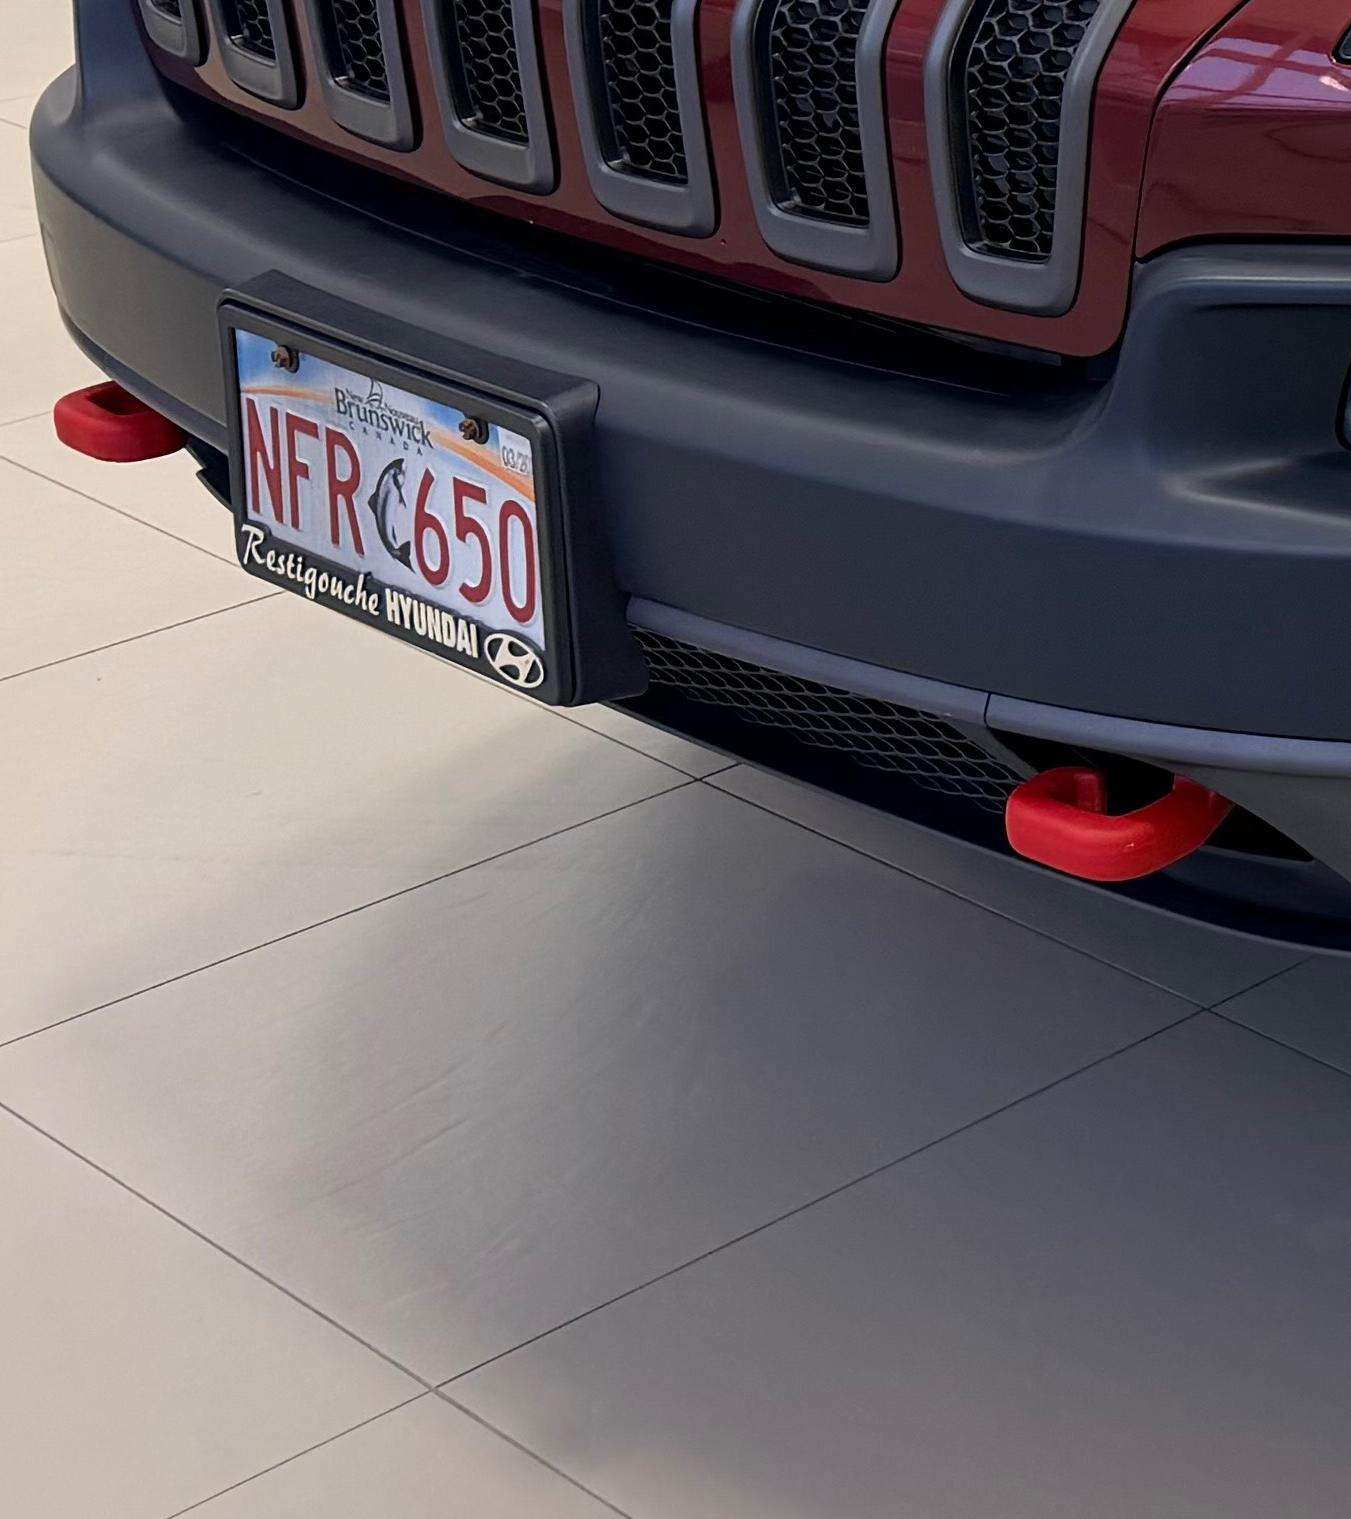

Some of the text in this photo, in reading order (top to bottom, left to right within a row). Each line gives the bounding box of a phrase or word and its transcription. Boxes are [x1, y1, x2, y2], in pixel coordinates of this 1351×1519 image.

[335, 387, 434, 449] Brunswick
[349, 422, 423, 456] CANADA
[246, 397, 537, 624] NFR 650
[241, 523, 479, 658] Restigouche HYUNDAI
